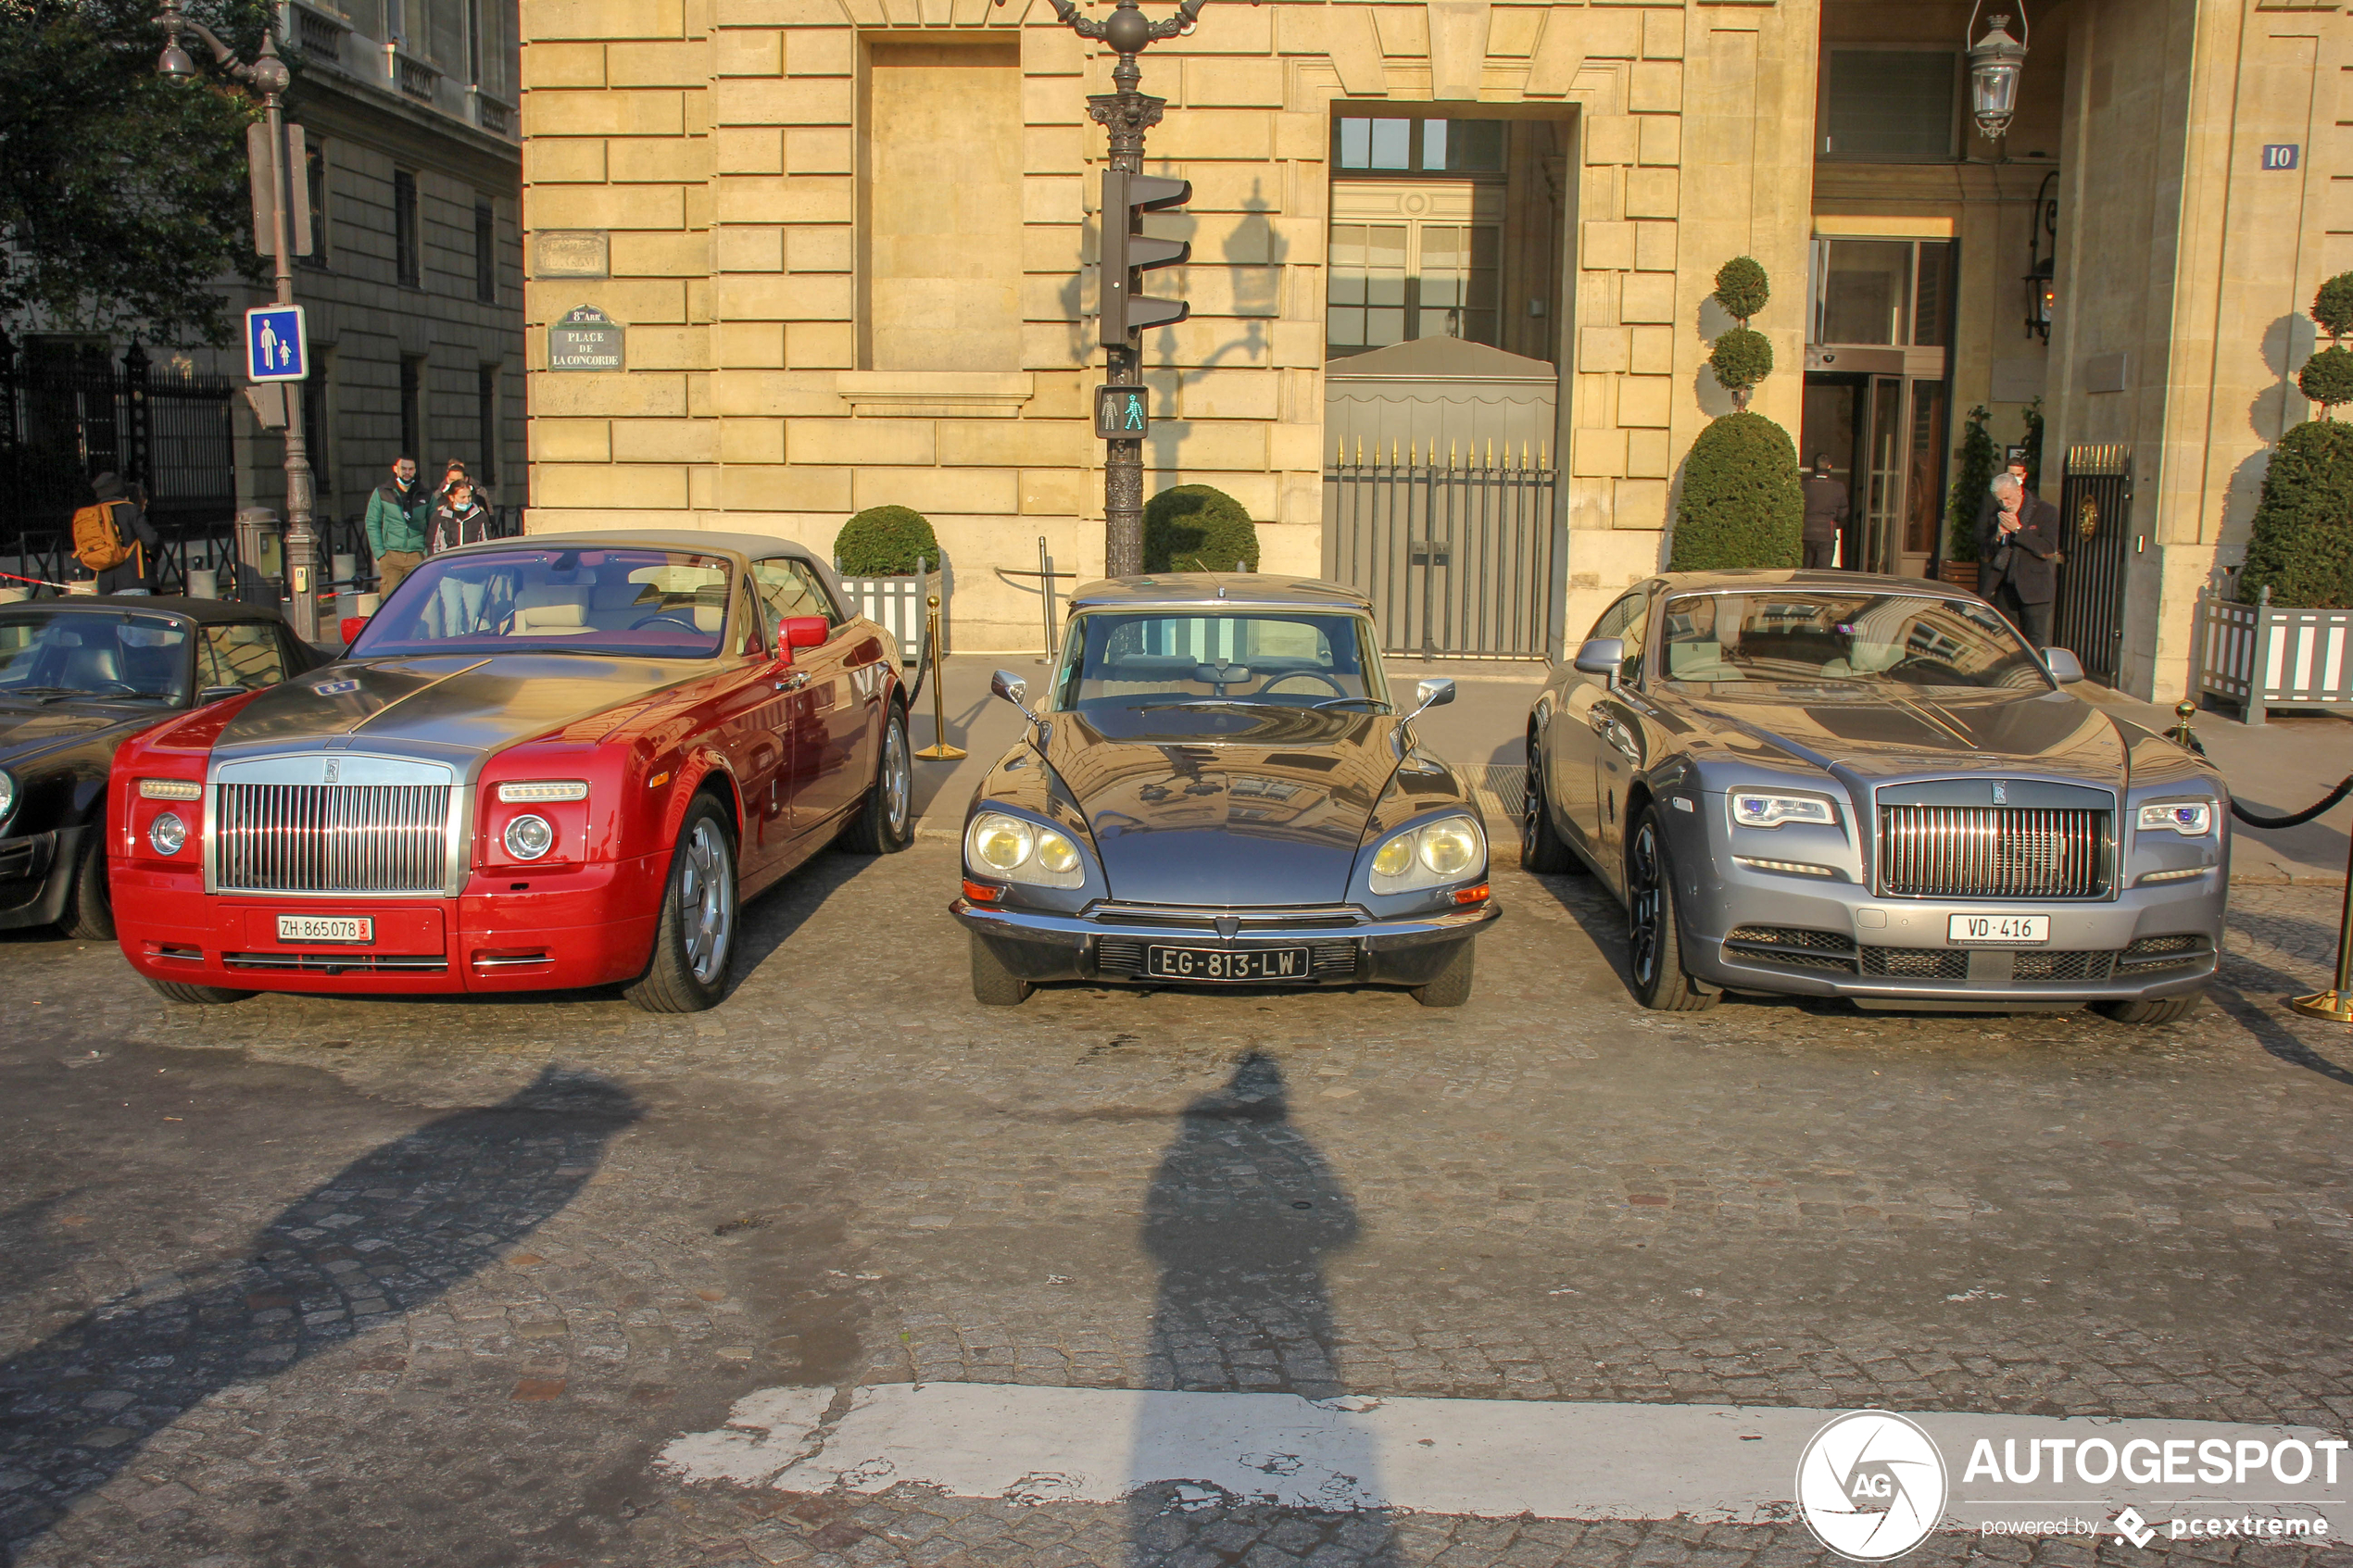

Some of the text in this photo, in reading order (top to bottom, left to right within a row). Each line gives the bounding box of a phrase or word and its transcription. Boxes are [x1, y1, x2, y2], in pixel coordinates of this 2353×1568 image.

[2269, 147, 2292, 167] 10
[568, 332, 604, 342] PLACE
[579, 345, 593, 353] DE
[553, 355, 618, 365] LA CONCORDE
[1692, 643, 1699, 652] R
[1163, 950, 1295, 977] EG-813-LW
